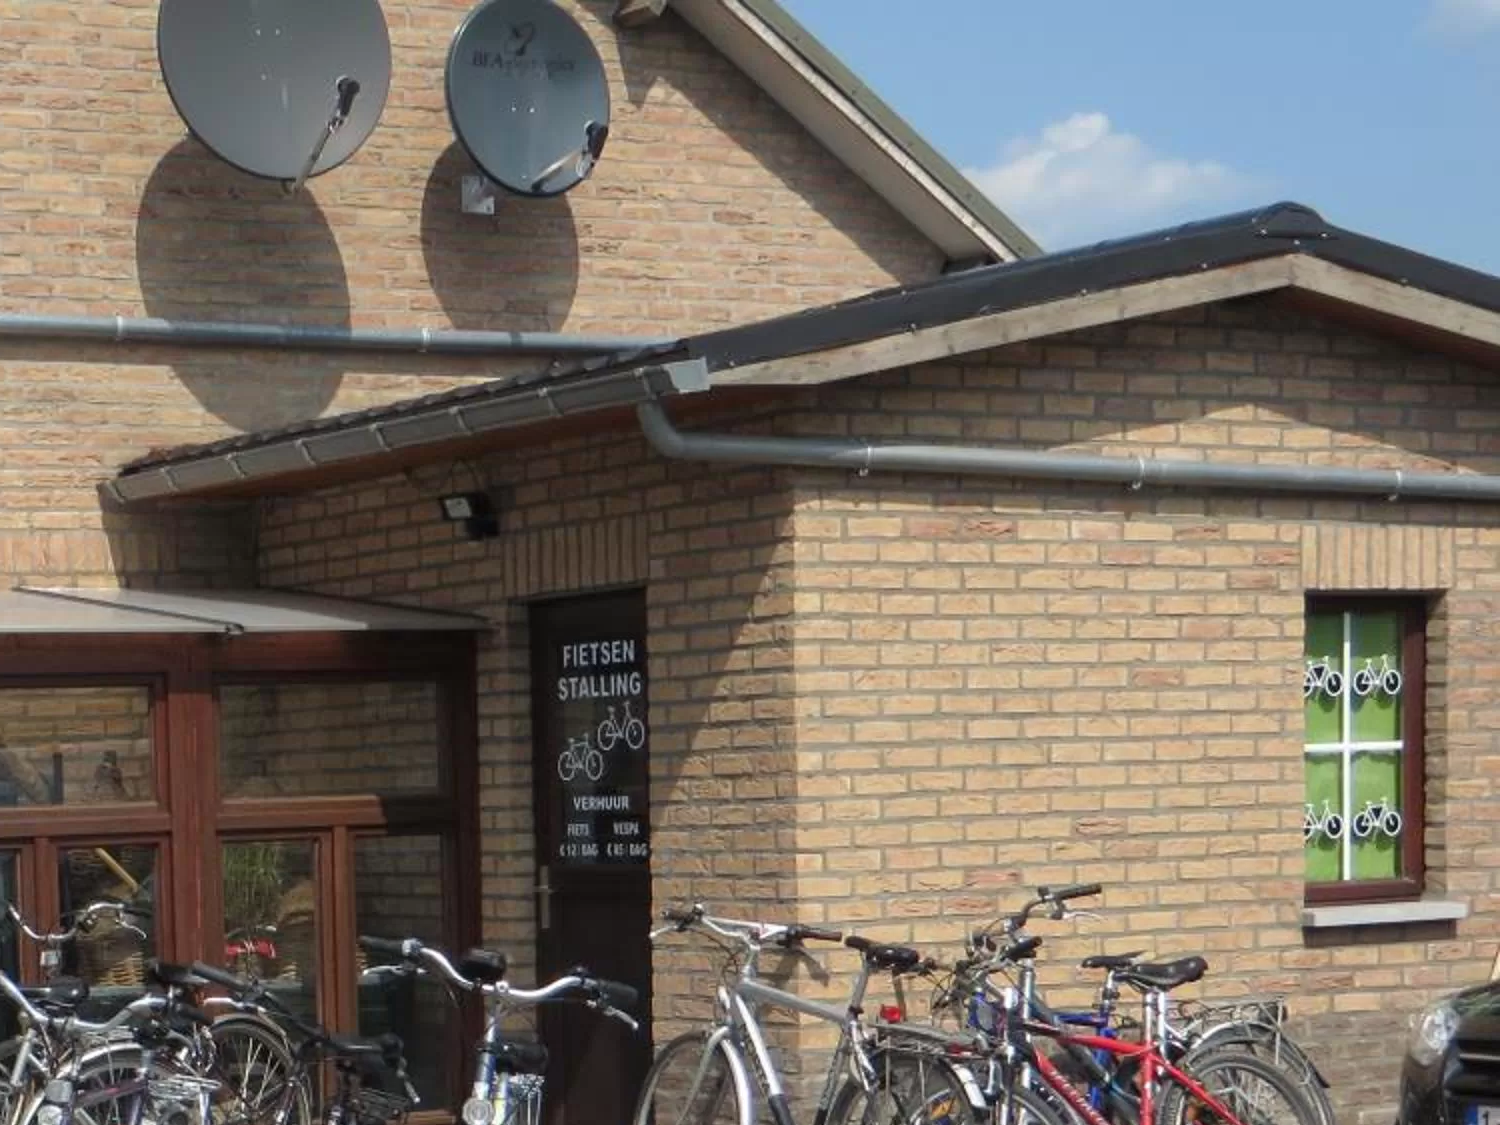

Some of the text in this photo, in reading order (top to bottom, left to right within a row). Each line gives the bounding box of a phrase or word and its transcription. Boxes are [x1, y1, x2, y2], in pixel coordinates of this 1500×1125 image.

[562, 639, 636, 669] FIETSEN
[557, 671, 642, 701] STALLING
[573, 795, 630, 811] VERHUUR
[567, 823, 590, 837] FIETS
[613, 821, 640, 836] VESPA
